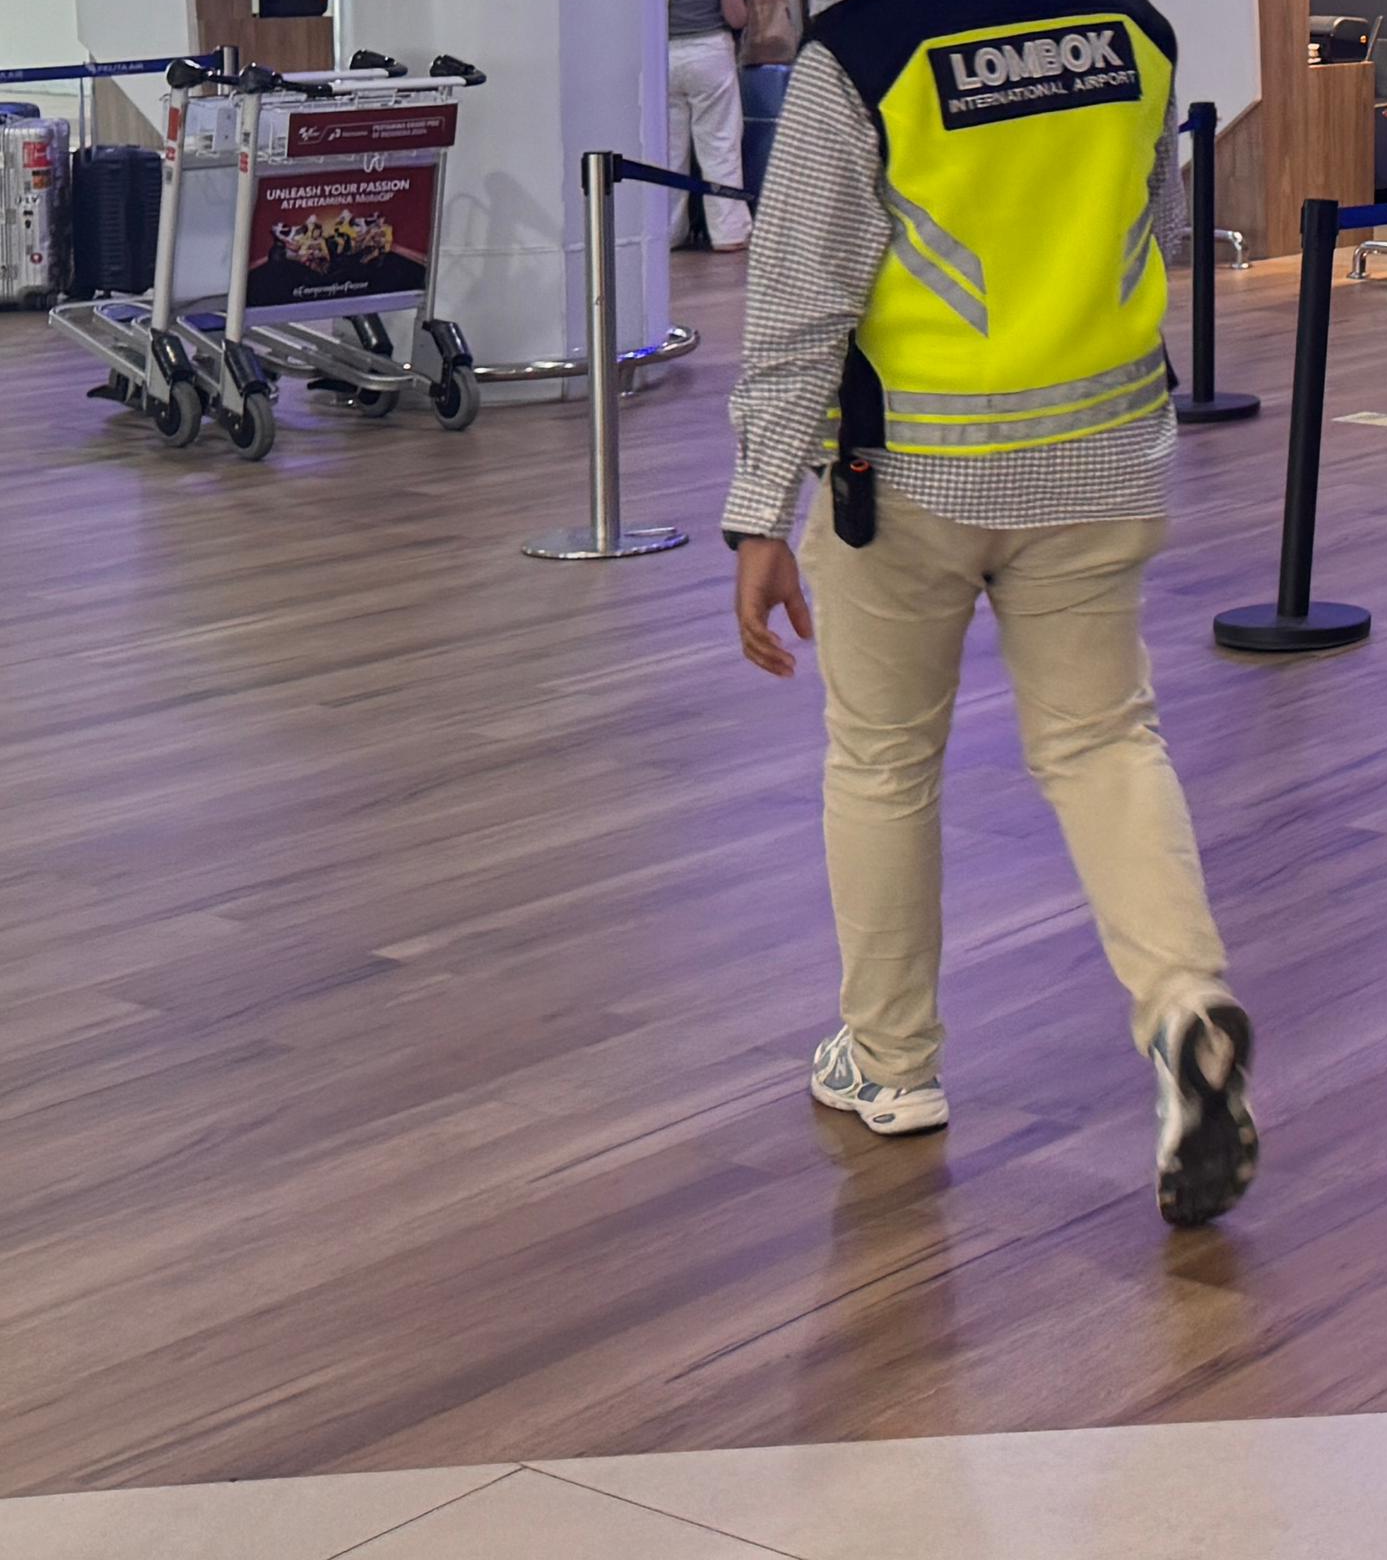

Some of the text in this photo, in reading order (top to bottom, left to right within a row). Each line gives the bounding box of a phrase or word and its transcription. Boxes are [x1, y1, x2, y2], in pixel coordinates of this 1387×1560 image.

[949, 30, 1124, 91] LOMBOK
[949, 70, 1136, 113] INTERNATIONAL AIRPORT
[266, 179, 410, 201] UNLEASH YOUR PASSION
[280, 199, 294, 209] AT
[295, 195, 352, 209] PERTAMINA
